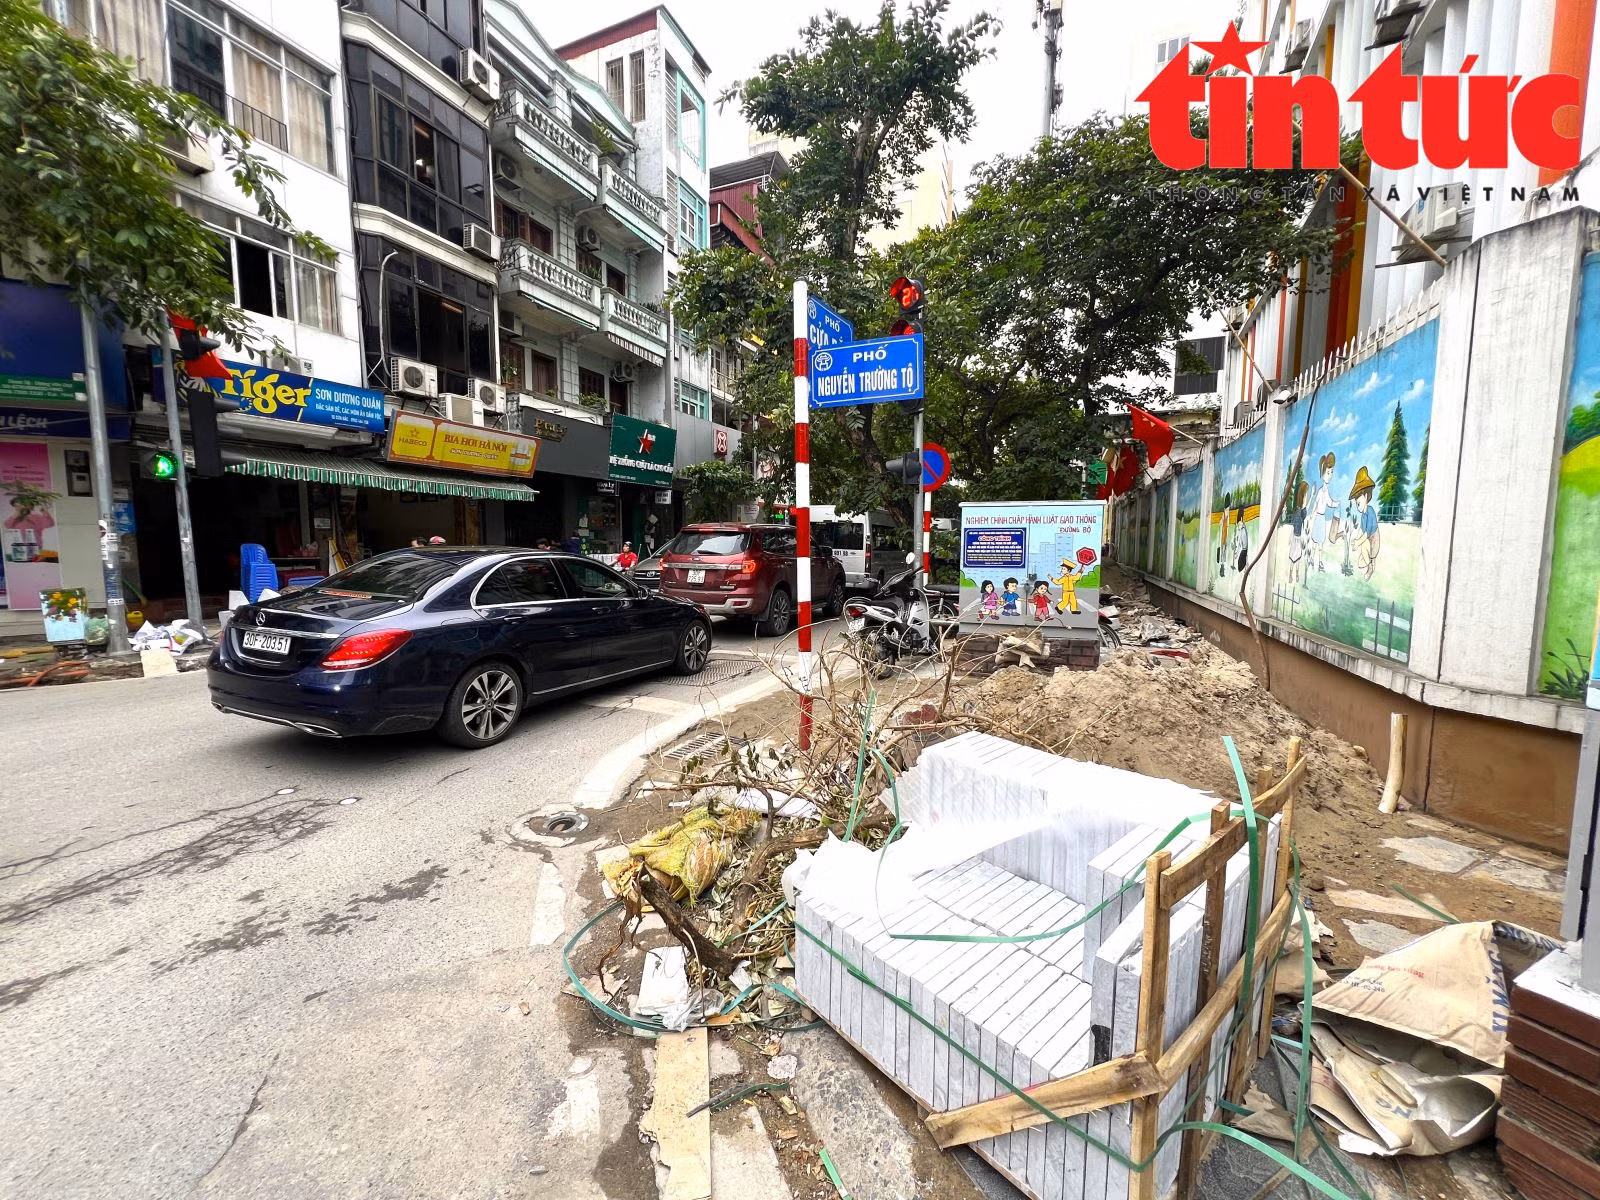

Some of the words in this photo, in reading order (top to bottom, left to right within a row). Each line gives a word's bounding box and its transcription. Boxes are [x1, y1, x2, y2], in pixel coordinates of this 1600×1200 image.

[824, 315, 840, 333] PHỐ
[852, 343, 889, 363] PHỐ
[817, 366, 856, 397] NGUYỄN
[859, 364, 897, 393] TRƯỜNG
[901, 362, 914, 393] TỘ
[221, 368, 312, 414] Tiger
[315, 388, 332, 401] SƠN
[333, 391, 360, 406] DƯƠNG
[398, 436, 428, 447] HABECO
[443, 434, 459, 445] BIA
[461, 437, 477, 448] HƠI
[478, 440, 491, 450] HÀ
[493, 442, 507, 453] NỘI
[1059, 515, 1074, 524] GIAO
[244, 632, 289, 653] 30F-203.51
